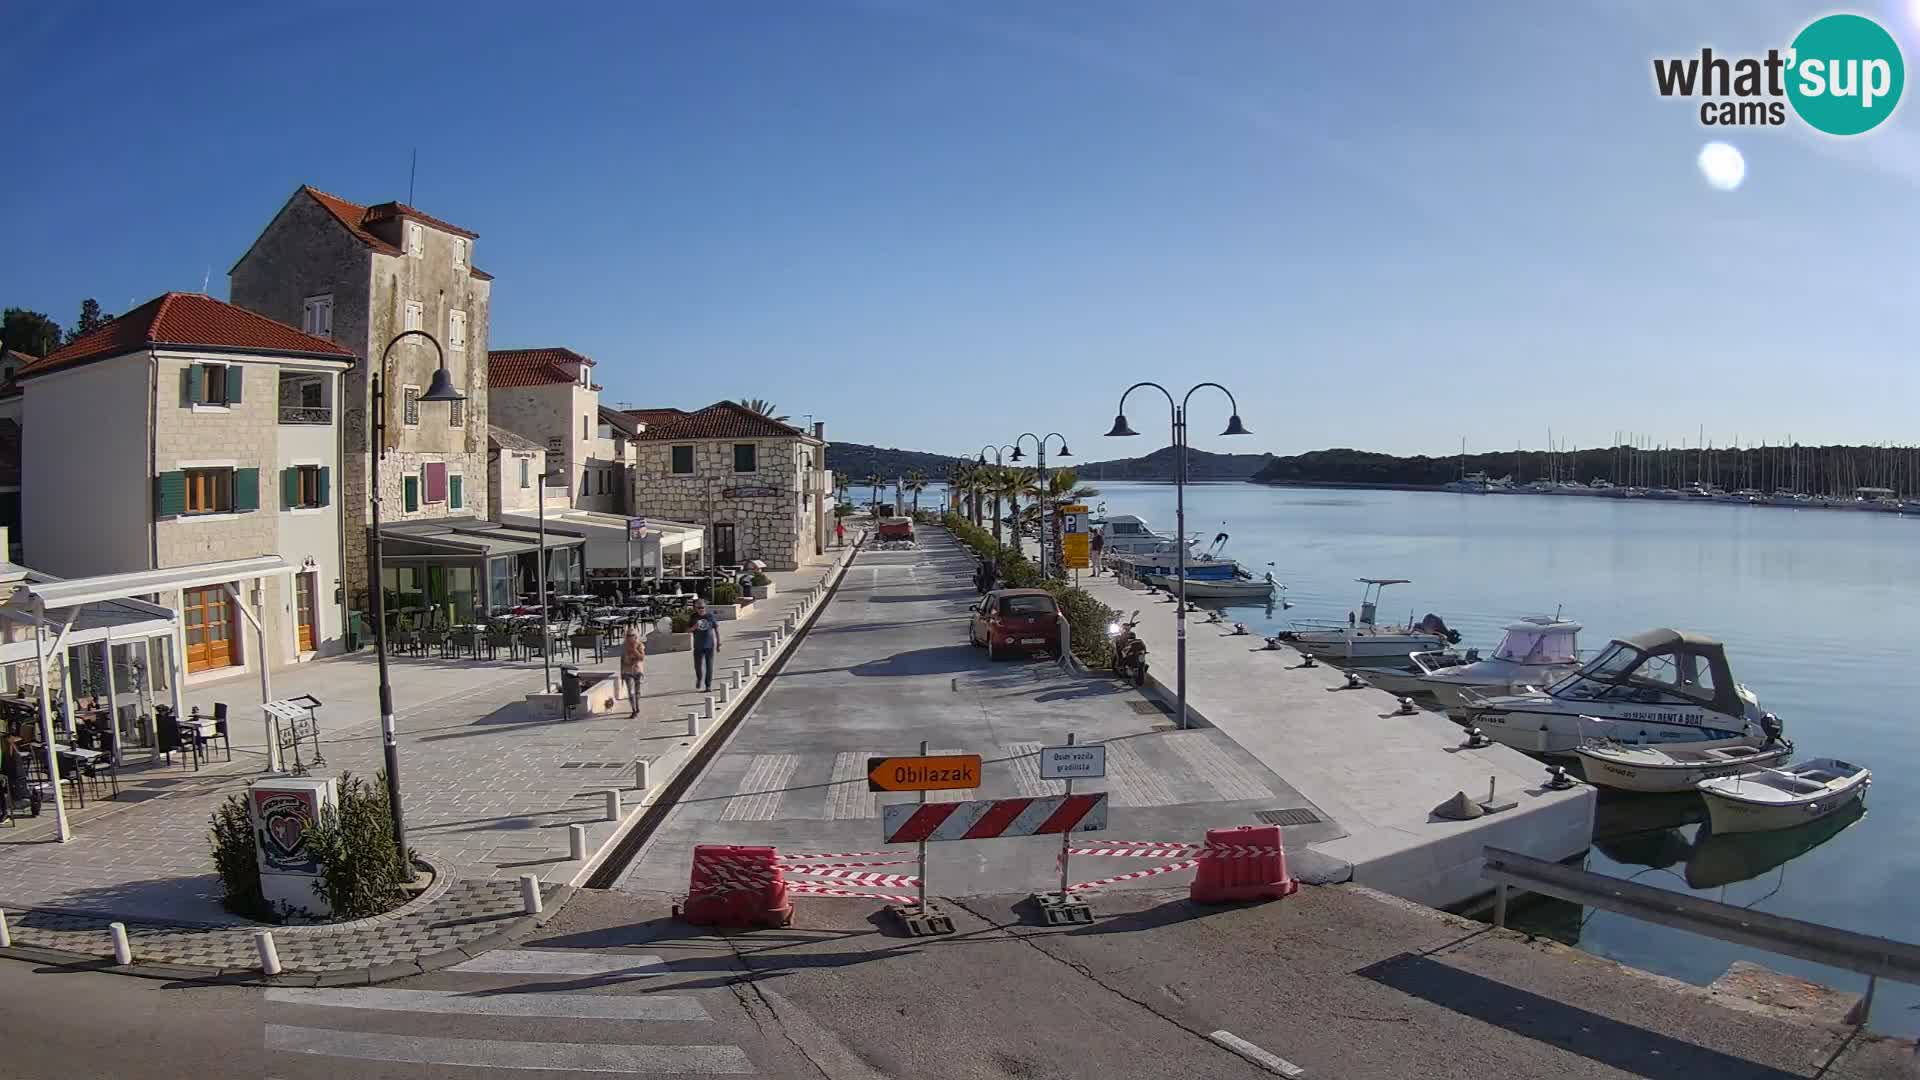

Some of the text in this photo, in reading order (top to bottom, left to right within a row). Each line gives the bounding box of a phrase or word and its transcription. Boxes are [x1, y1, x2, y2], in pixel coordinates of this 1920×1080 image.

[1657, 712, 1677, 722] RENT
[1685, 714, 1704, 725] BOAT
[895, 764, 974, 785] Obilazak
